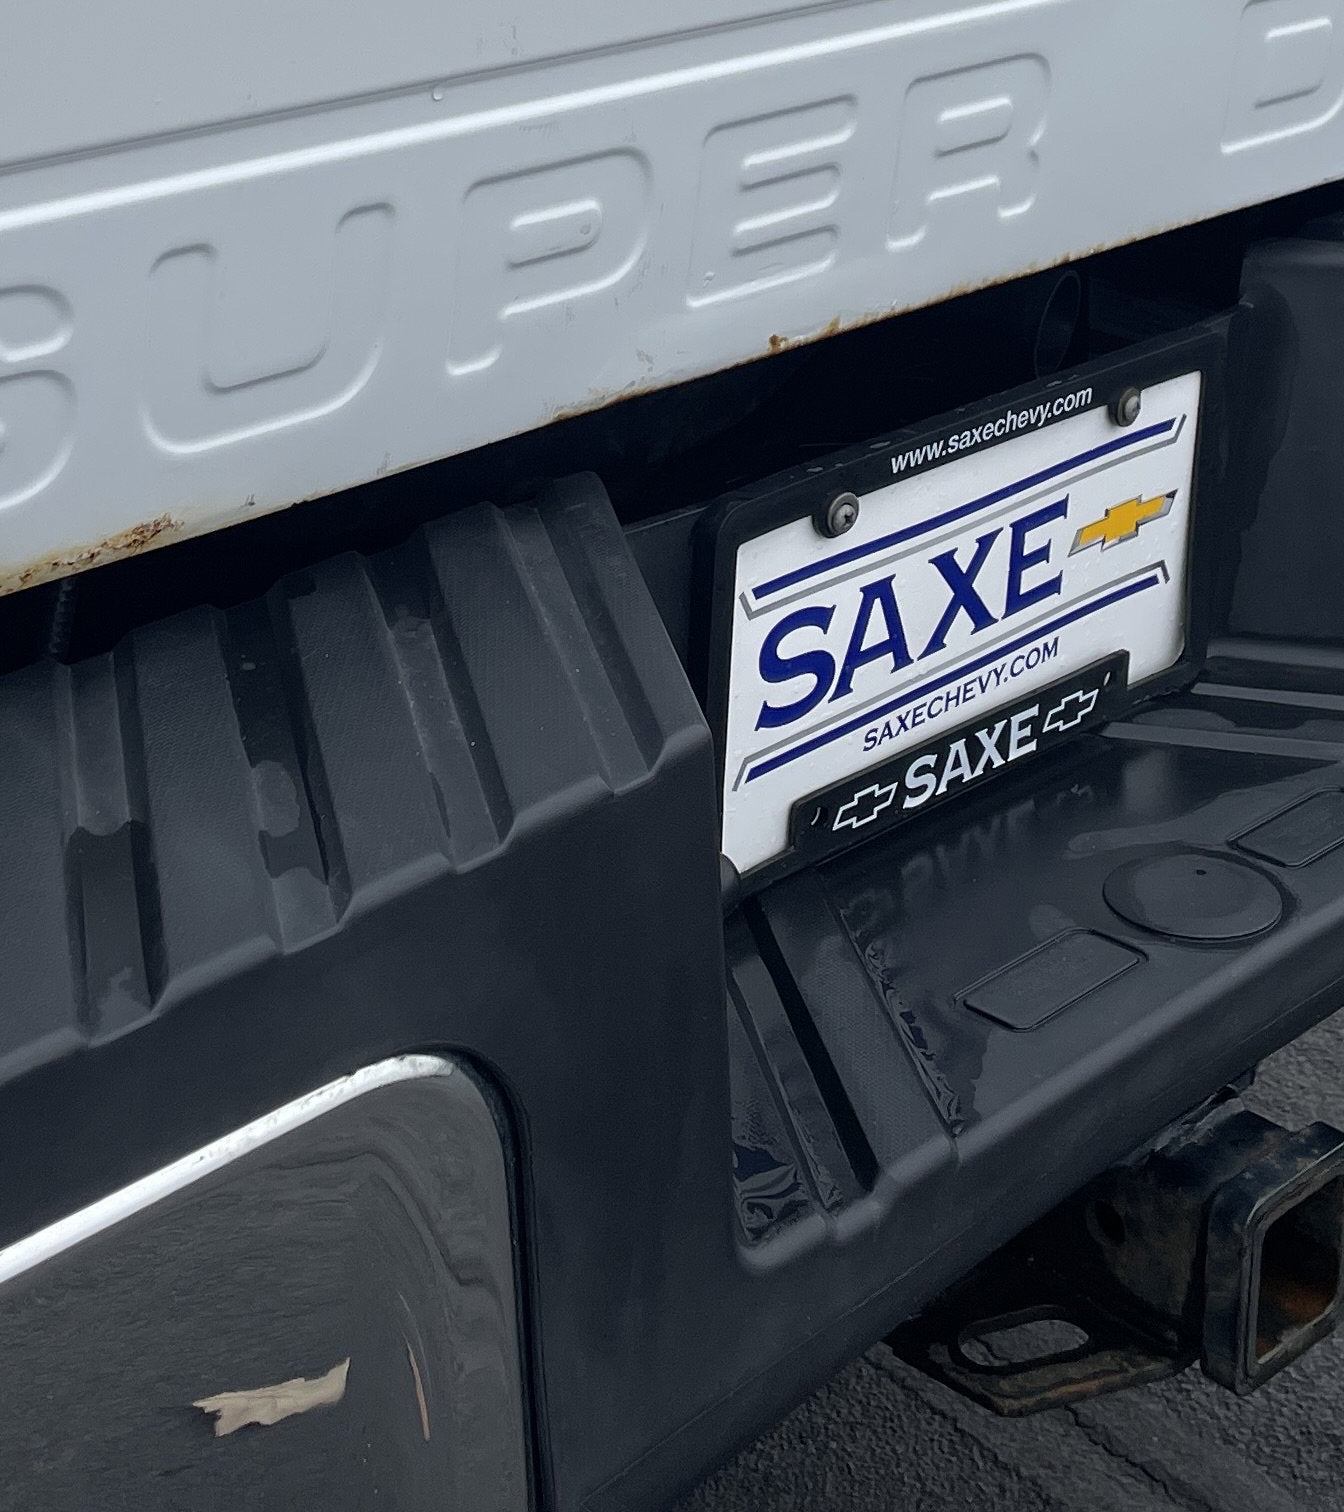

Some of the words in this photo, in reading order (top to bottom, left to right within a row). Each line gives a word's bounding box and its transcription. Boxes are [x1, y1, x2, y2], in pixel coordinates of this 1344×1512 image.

[890, 386, 1093, 474] www.saxechevy.com
[754, 494, 1070, 731] SAXE
[862, 637, 1059, 752] SAXECHEVY.COM
[902, 704, 1039, 810] SAXE
